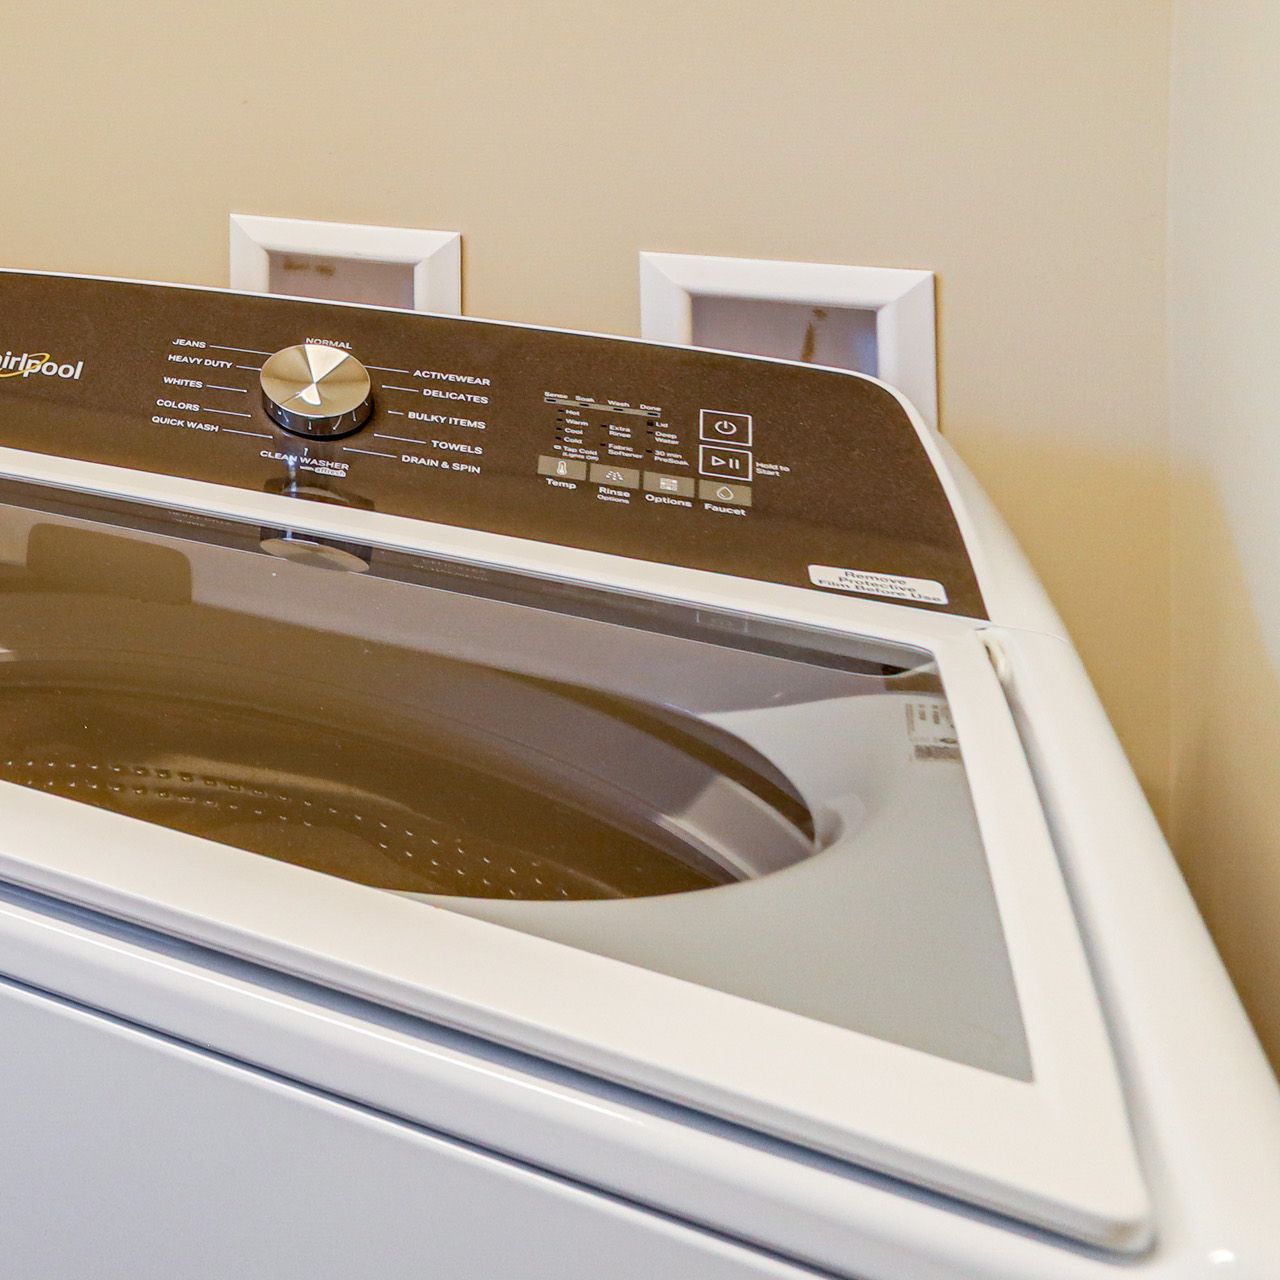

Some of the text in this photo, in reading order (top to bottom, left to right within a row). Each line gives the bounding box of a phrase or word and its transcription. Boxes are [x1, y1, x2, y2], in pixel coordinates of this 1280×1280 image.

[172, 338, 207, 349] JEANS
[306, 337, 352, 350] NORMAL
[168, 354, 233, 369] HEAVY DUTY
[163, 376, 203, 389] WHITES
[413, 370, 490, 386] ACTIVEWEAR
[423, 388, 489, 404] DELICATES
[544, 391, 568, 399] Sense
[156, 399, 200, 412] COLORS
[607, 399, 630, 408] Wash
[640, 404, 662, 412] Done
[151, 416, 219, 432] QUICK WASH
[408, 411, 486, 429] BULKY ITEMS
[565, 418, 589, 426] Warm
[564, 427, 583, 435] Cool
[609, 424, 631, 432] Extra
[563, 436, 583, 444] Cold
[655, 431, 677, 439] Deep
[655, 437, 680, 445] Water
[431, 439, 483, 455] TOWELS
[608, 443, 634, 451] Fabric
[608, 449, 643, 459] Softener
[260, 450, 349, 471] CLEAN WASHER
[401, 454, 481, 474] DRAIN & SPIN
[654, 455, 689, 466] PreSoak
[755, 461, 779, 470] Hold
[755, 467, 780, 476] Start
[545, 477, 577, 490] Temp
[598, 486, 631, 497] Rinse
[597, 493, 630, 504] Options
[645, 493, 692, 508] Options
[703, 502, 747, 516] Faucet
[839, 576, 917, 592] Protective
[844, 571, 907, 585] Remove
[819, 579, 941, 601] Film Before Use
